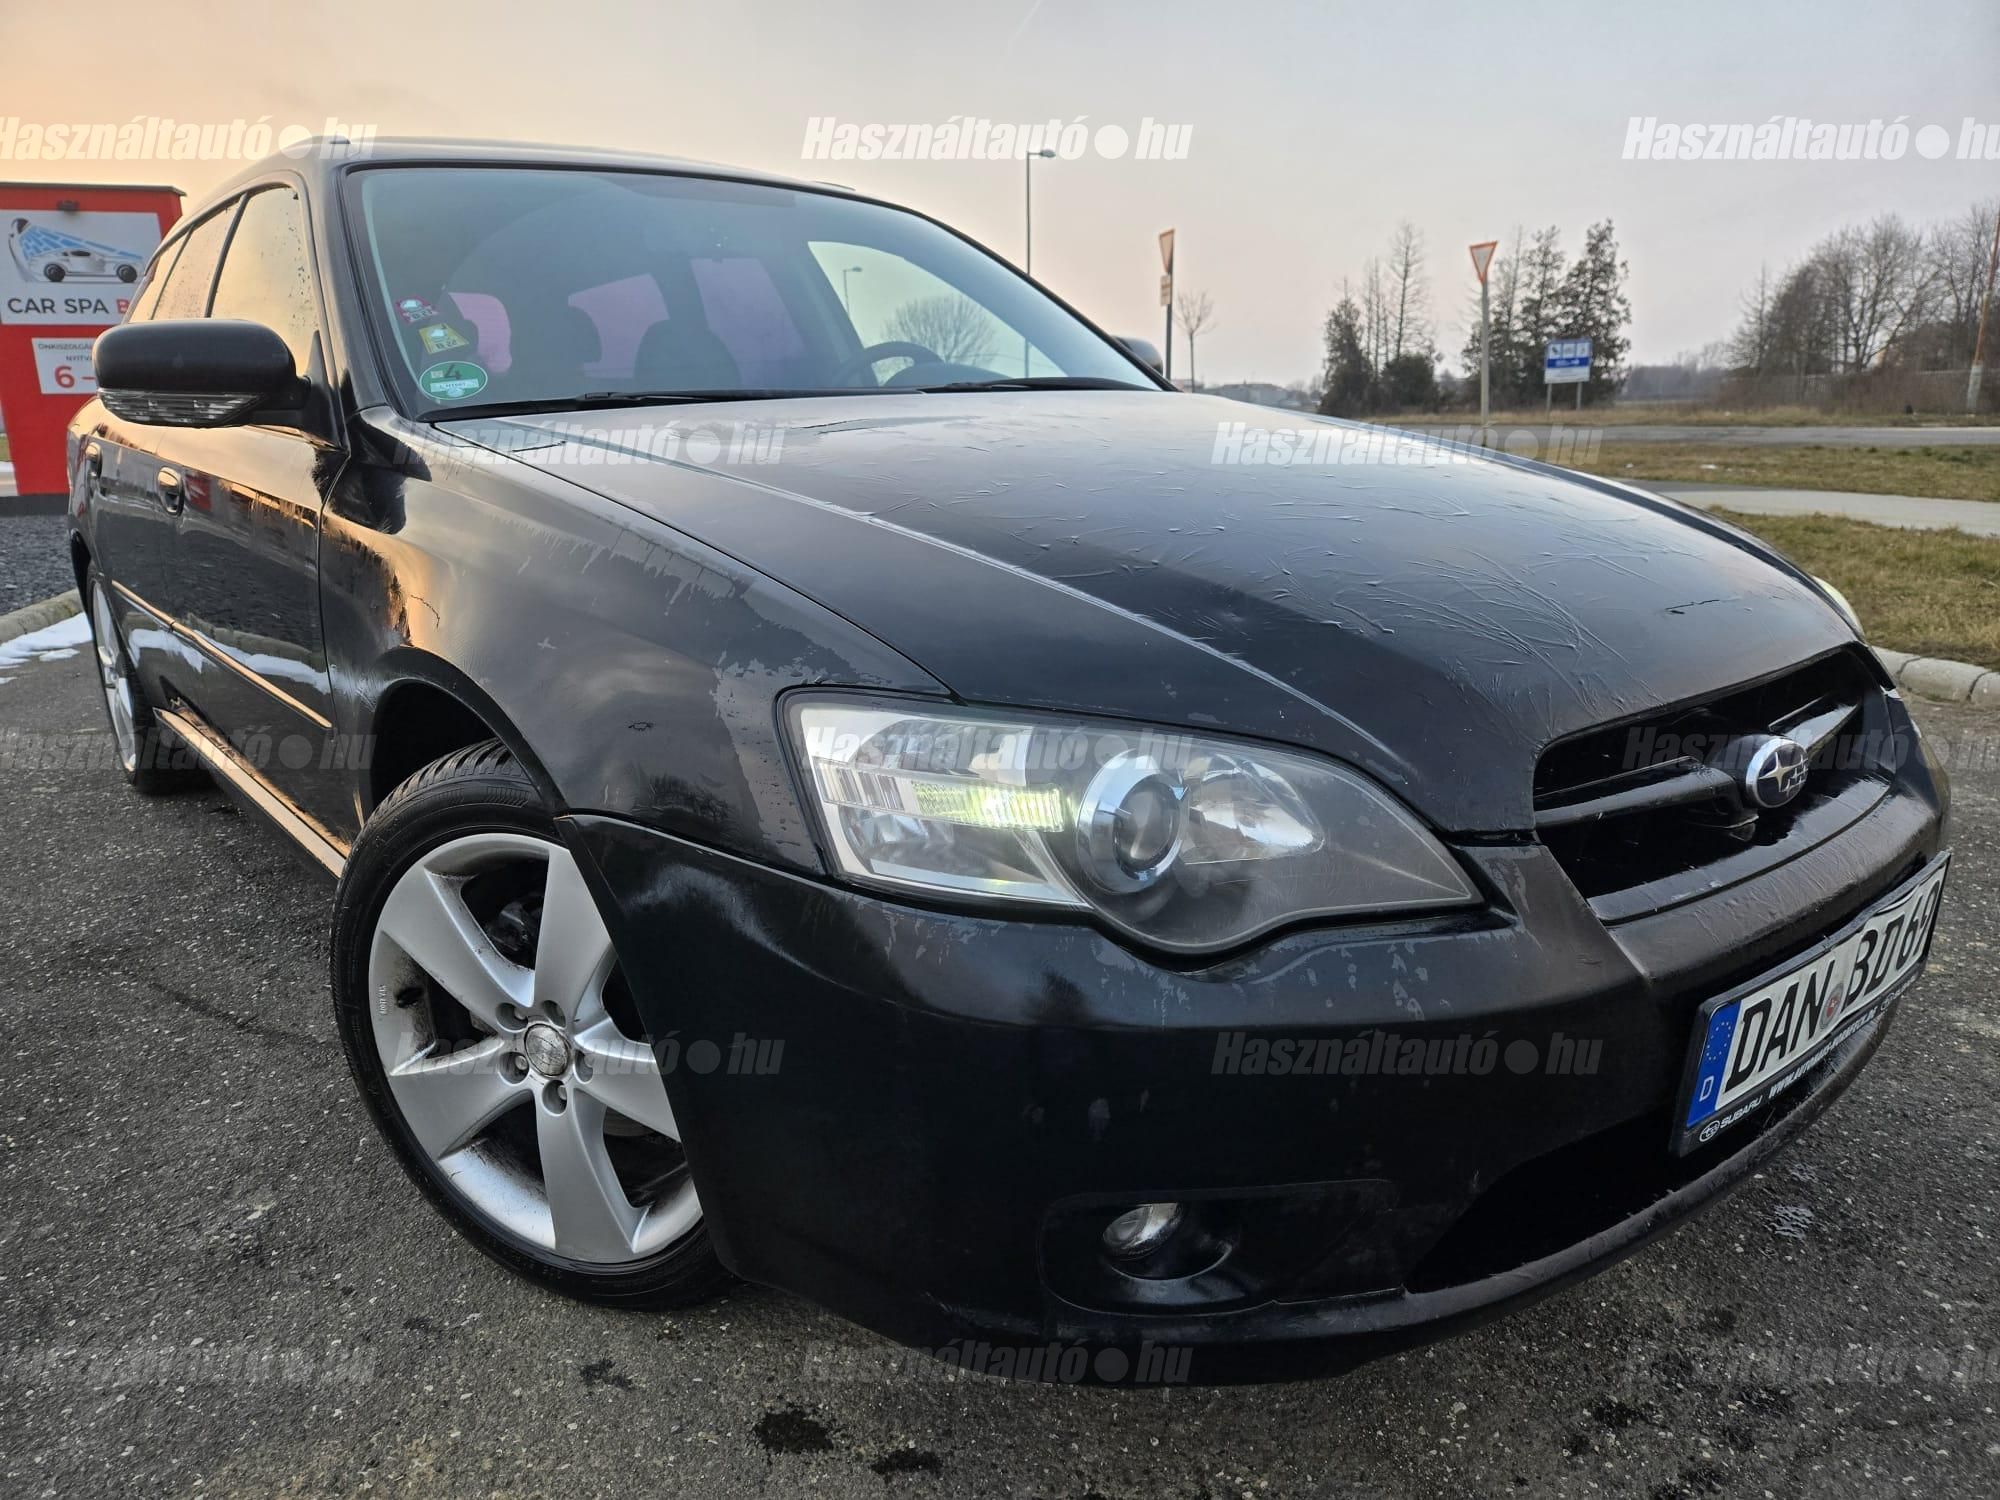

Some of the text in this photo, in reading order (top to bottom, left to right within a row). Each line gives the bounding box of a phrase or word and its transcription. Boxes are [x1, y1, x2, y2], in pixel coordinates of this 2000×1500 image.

[8, 298, 56, 314] CAR
[65, 298, 109, 314] SPA
[1724, 959, 1835, 1093] DAN
[1719, 1096, 1763, 1129] SUBARU
